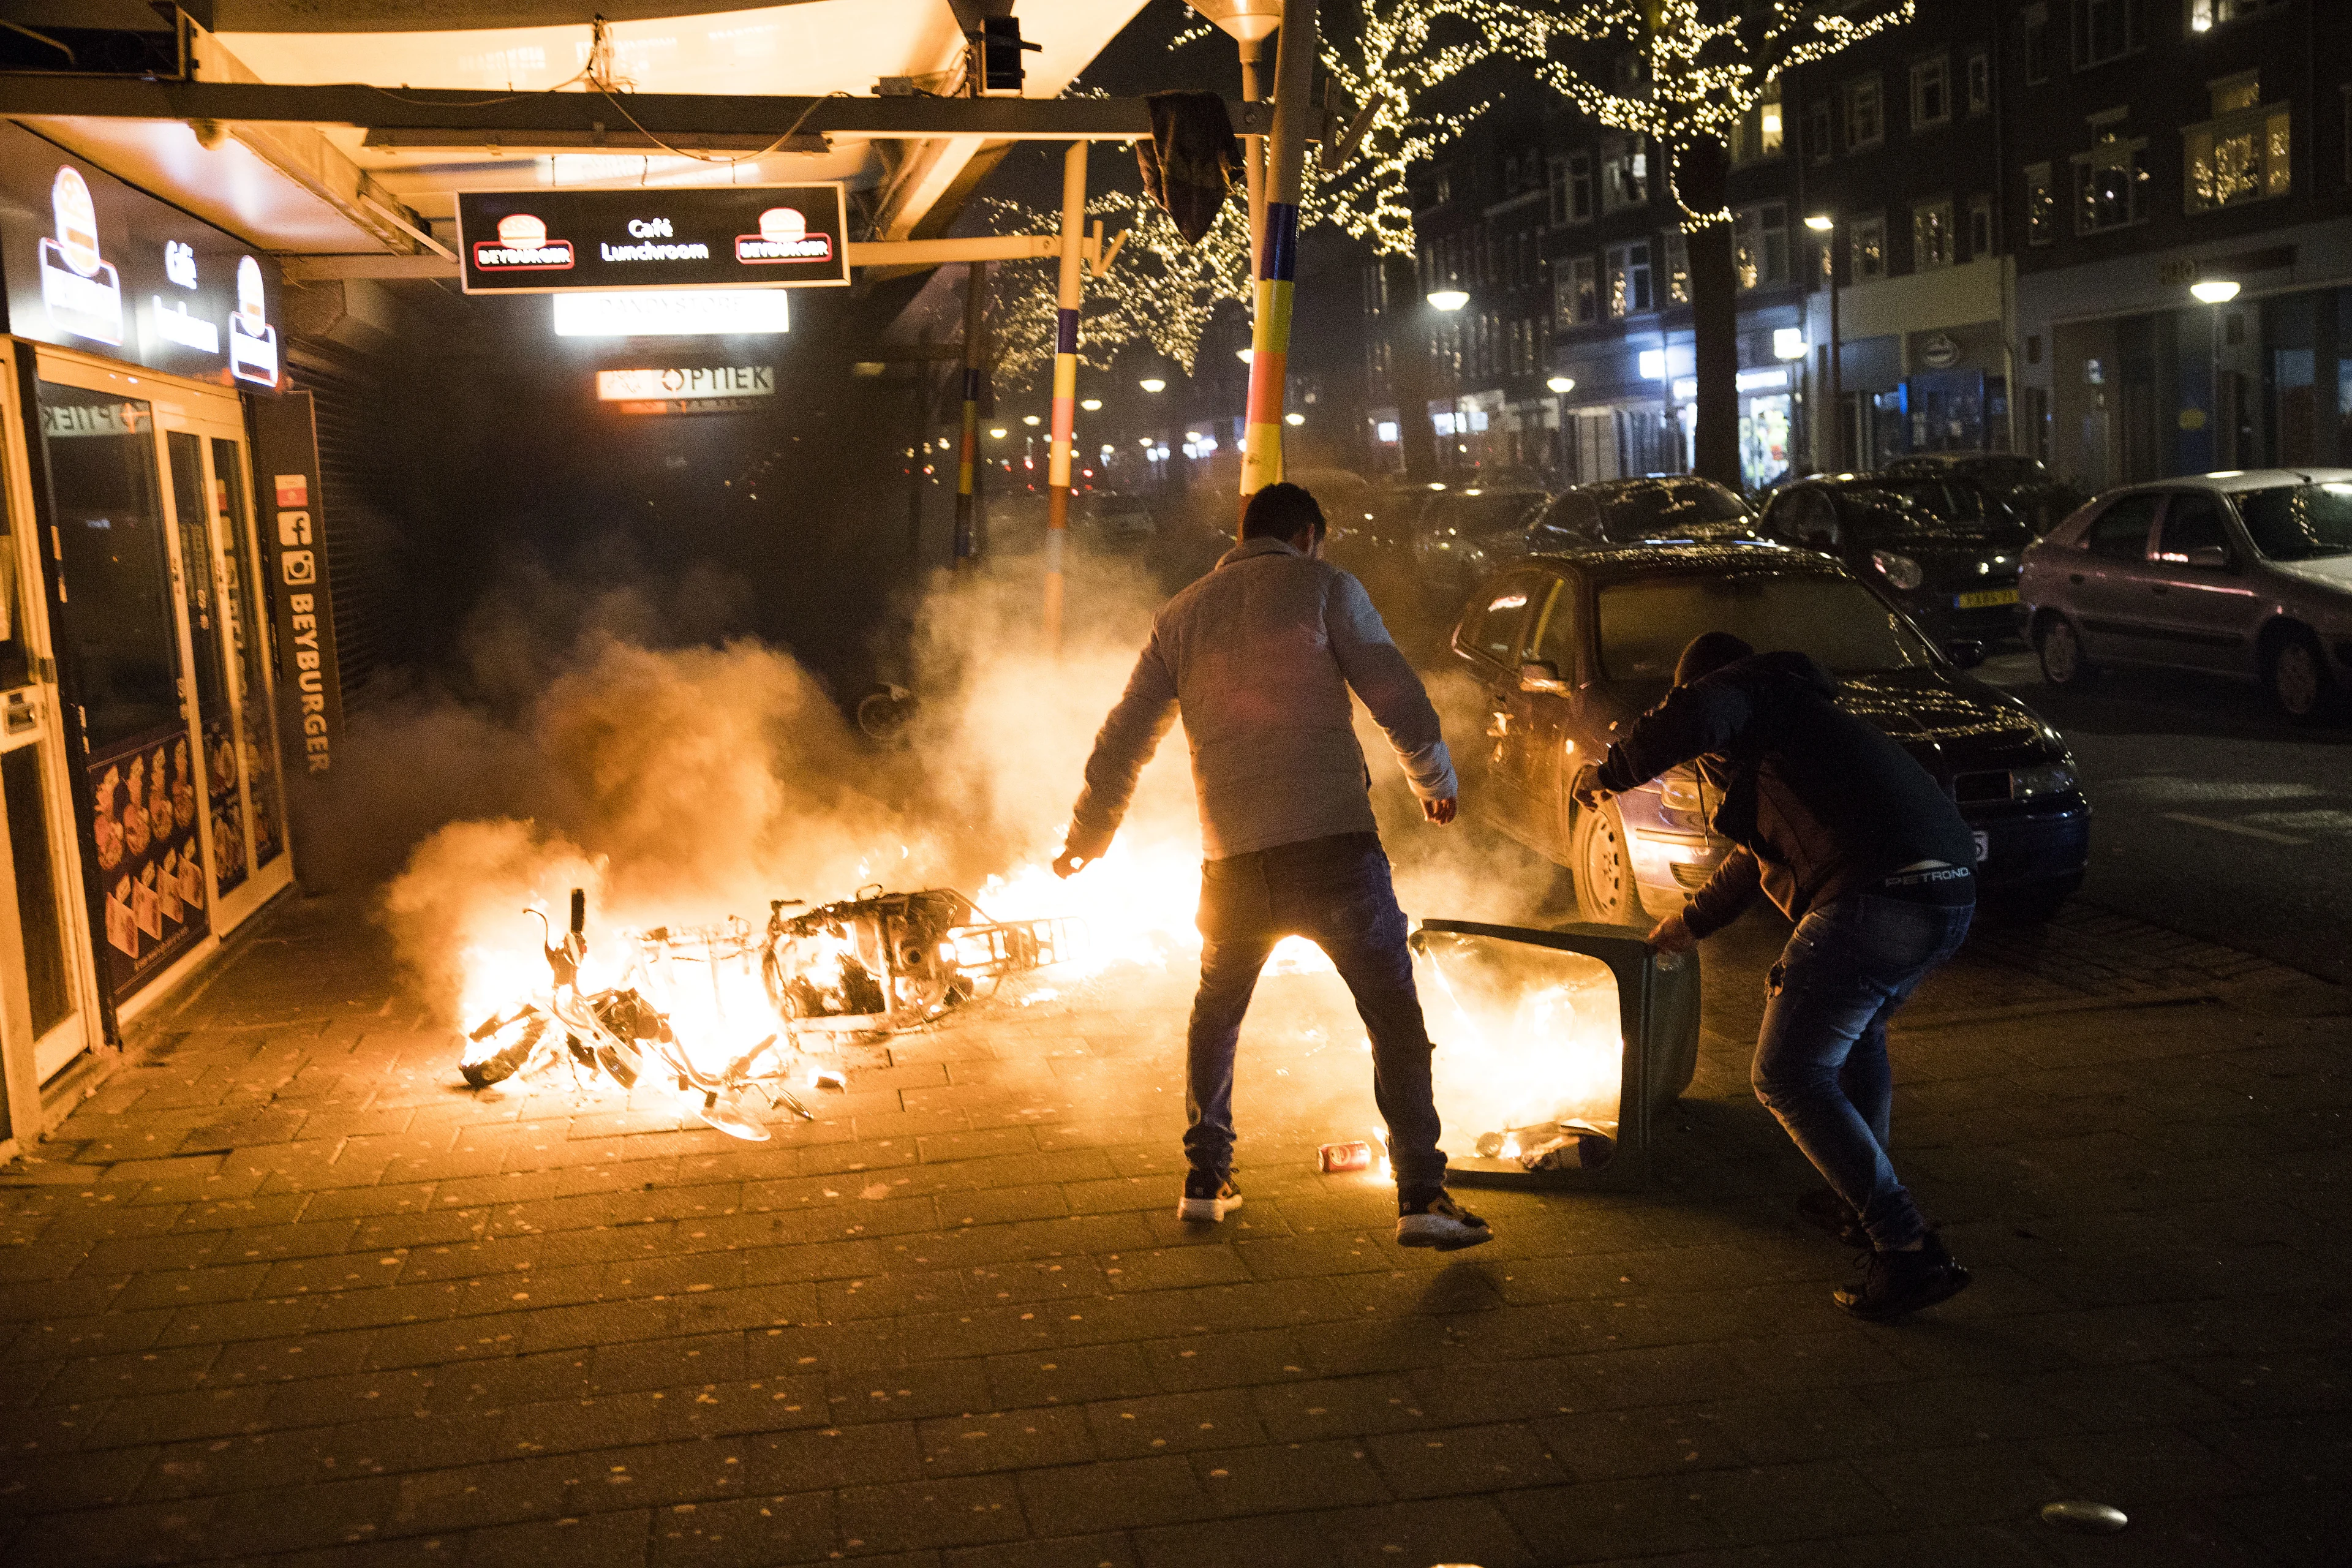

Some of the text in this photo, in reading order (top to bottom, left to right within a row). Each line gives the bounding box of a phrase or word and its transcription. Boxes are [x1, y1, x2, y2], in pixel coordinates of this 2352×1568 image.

[628, 217, 674, 238] Café
[601, 241, 709, 261] Lunchroom
[662, 366, 770, 392] OPTIEK
[290, 593, 330, 774] BEYBURGER
